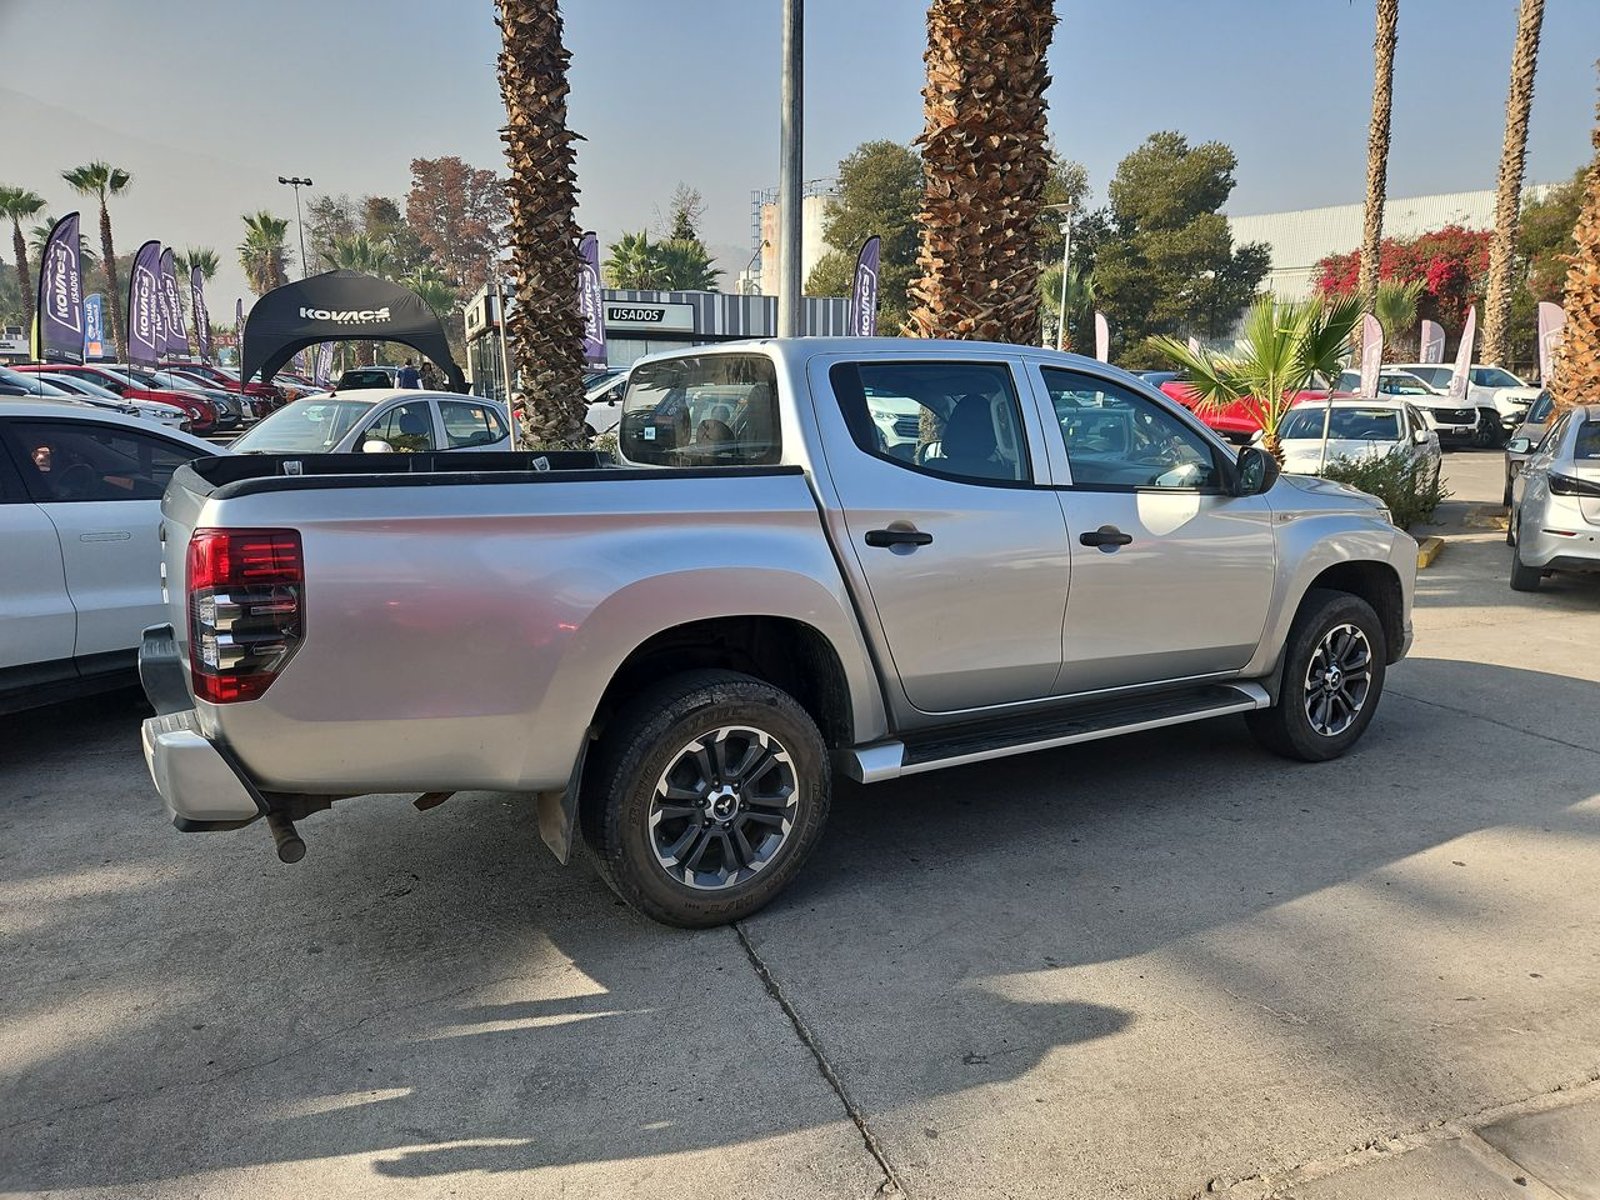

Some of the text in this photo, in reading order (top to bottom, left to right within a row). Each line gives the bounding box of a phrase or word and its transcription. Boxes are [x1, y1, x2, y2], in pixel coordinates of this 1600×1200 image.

[55, 248, 69, 319] KOVACS
[69, 270, 80, 304] USADOS
[140, 276, 149, 337] KOVACS
[165, 280, 178, 330] KOVACS
[583, 270, 597, 332] KOVACS
[861, 274, 870, 335] KOVACS
[299, 307, 390, 321] KOVACS
[613, 309, 660, 321] USADOS
